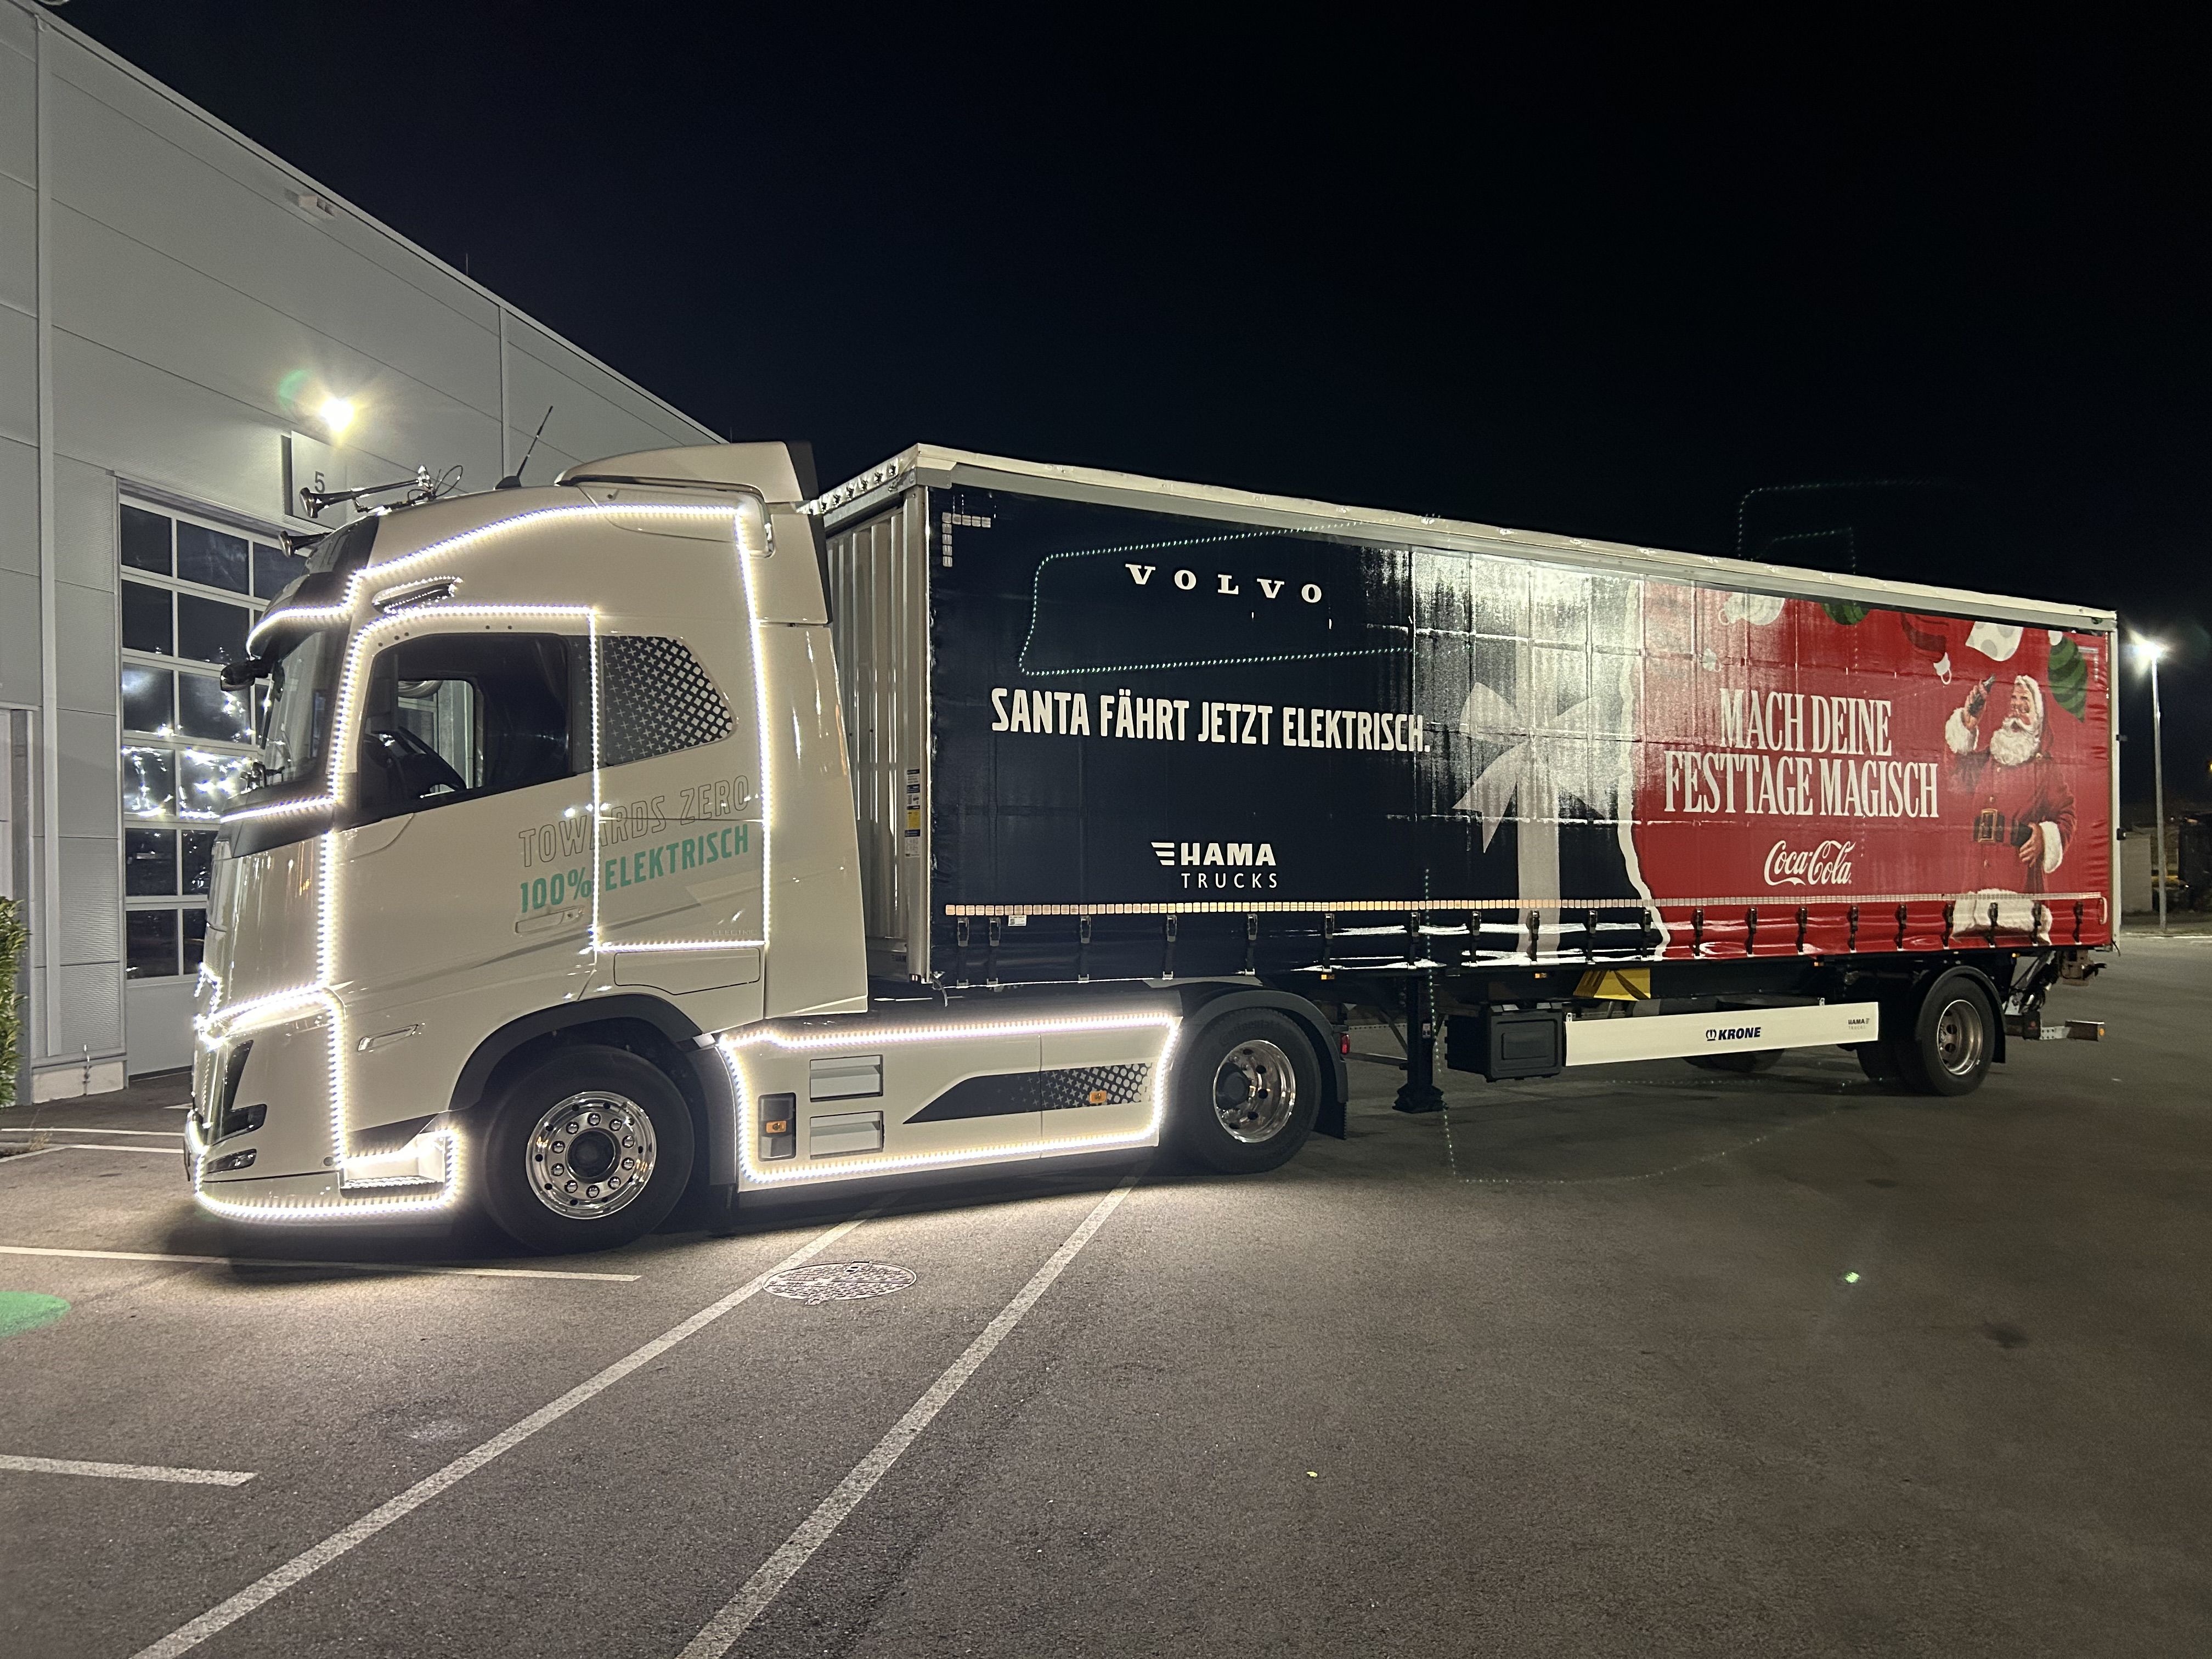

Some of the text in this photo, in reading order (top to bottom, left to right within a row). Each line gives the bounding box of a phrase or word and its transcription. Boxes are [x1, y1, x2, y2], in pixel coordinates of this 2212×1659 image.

[314, 471, 325, 493] 5
[1125, 563, 1322, 603] VOLVO
[991, 687, 1431, 752] SANTA FÄHRT JETZT ELEKTRISCH.
[1719, 687, 1892, 757] MACH DEINE
[1663, 749, 1940, 819] FESTTAGE MAGISCH
[518, 775, 749, 867] TOWARDS ZERO
[520, 823, 749, 913] 100% ELEKTRISCH
[1181, 842, 1277, 866] HAMA
[1764, 840, 1857, 886] Coca-Cola
[1181, 873, 1278, 889] TRUCKS
[1718, 1026, 1762, 1041] KRONE
